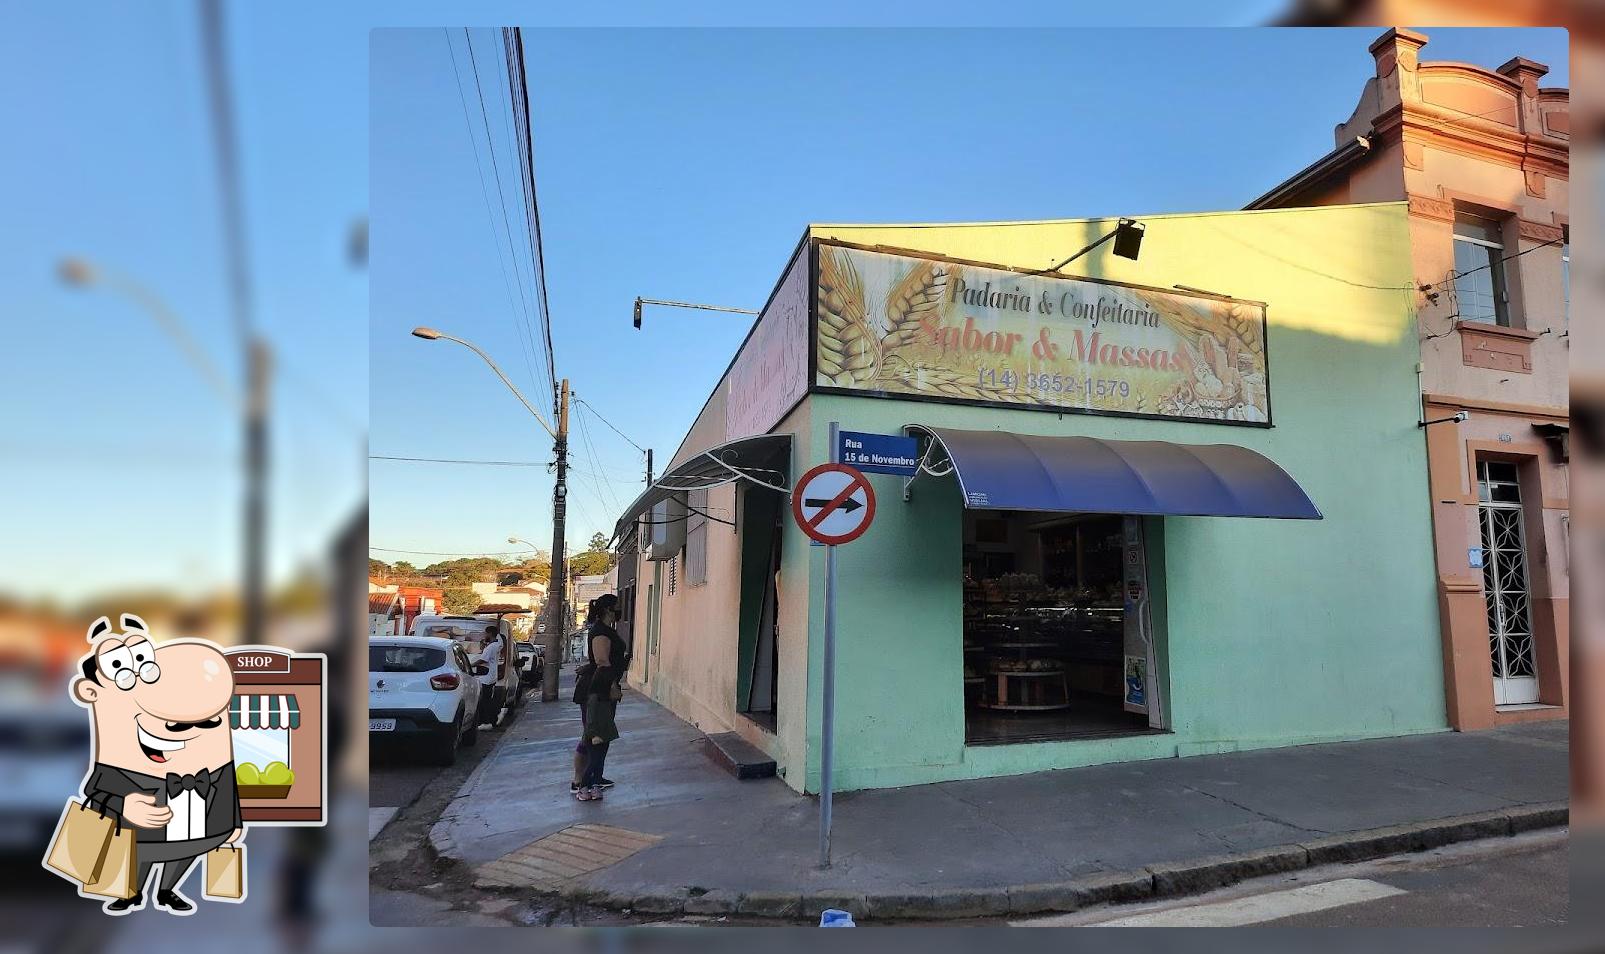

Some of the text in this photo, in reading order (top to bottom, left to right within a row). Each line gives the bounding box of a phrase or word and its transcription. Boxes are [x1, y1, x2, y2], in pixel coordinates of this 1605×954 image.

[951, 278, 1160, 328] Padaria & Confeitaria
[917, 314, 1185, 372] Sabor & Massas
[977, 366, 1130, 398] (14) 3652-1579
[845, 453, 914, 465] 15 de Novembro
[846, 439, 862, 449] Rua
